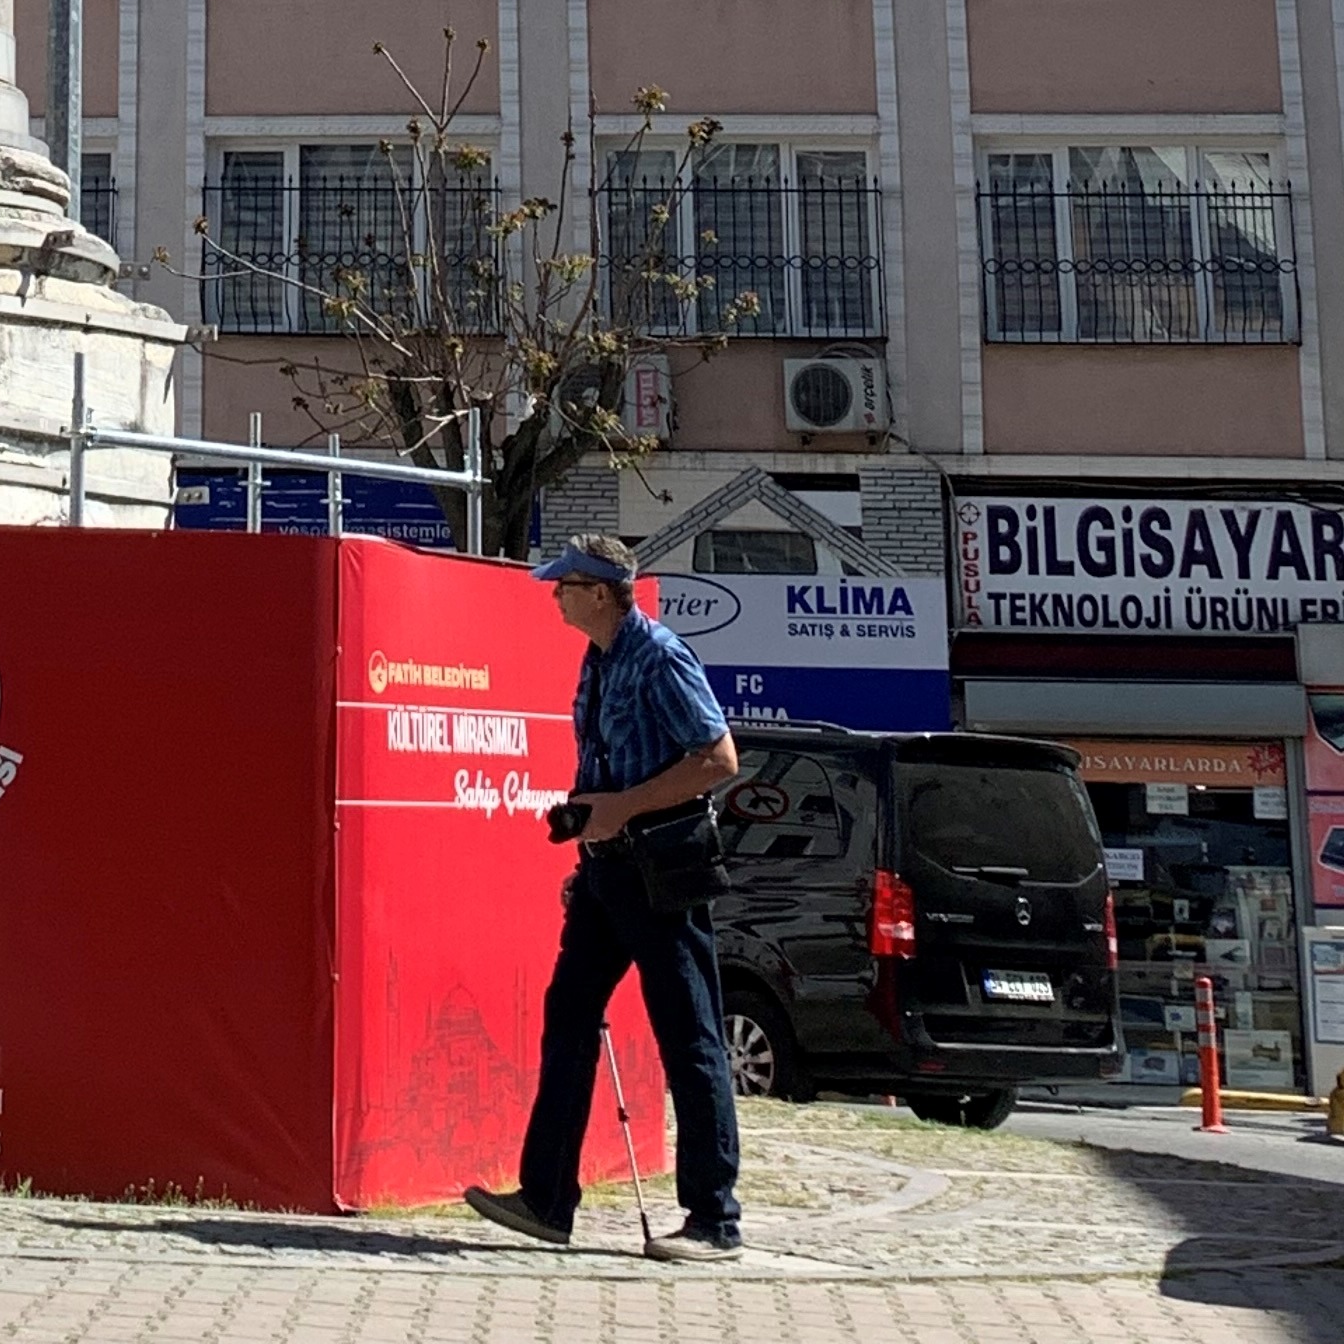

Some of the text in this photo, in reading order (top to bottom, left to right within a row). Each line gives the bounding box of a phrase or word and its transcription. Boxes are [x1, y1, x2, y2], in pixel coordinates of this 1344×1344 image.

[863, 366, 878, 412] arçelik
[786, 578, 915, 616] KLİMA
[961, 531, 982, 625] PUSULA
[987, 586, 1344, 631] TEKNOLOJİ ÜRÜNLER
[787, 623, 835, 640] SATIŞ
[840, 624, 851, 637] &
[388, 659, 490, 690] FATİH BELEDİYESİ
[736, 674, 764, 694] FC
[387, 705, 529, 756] KÜLTÜREL MİRASIMIZA
[454, 769, 501, 820] Sahip
